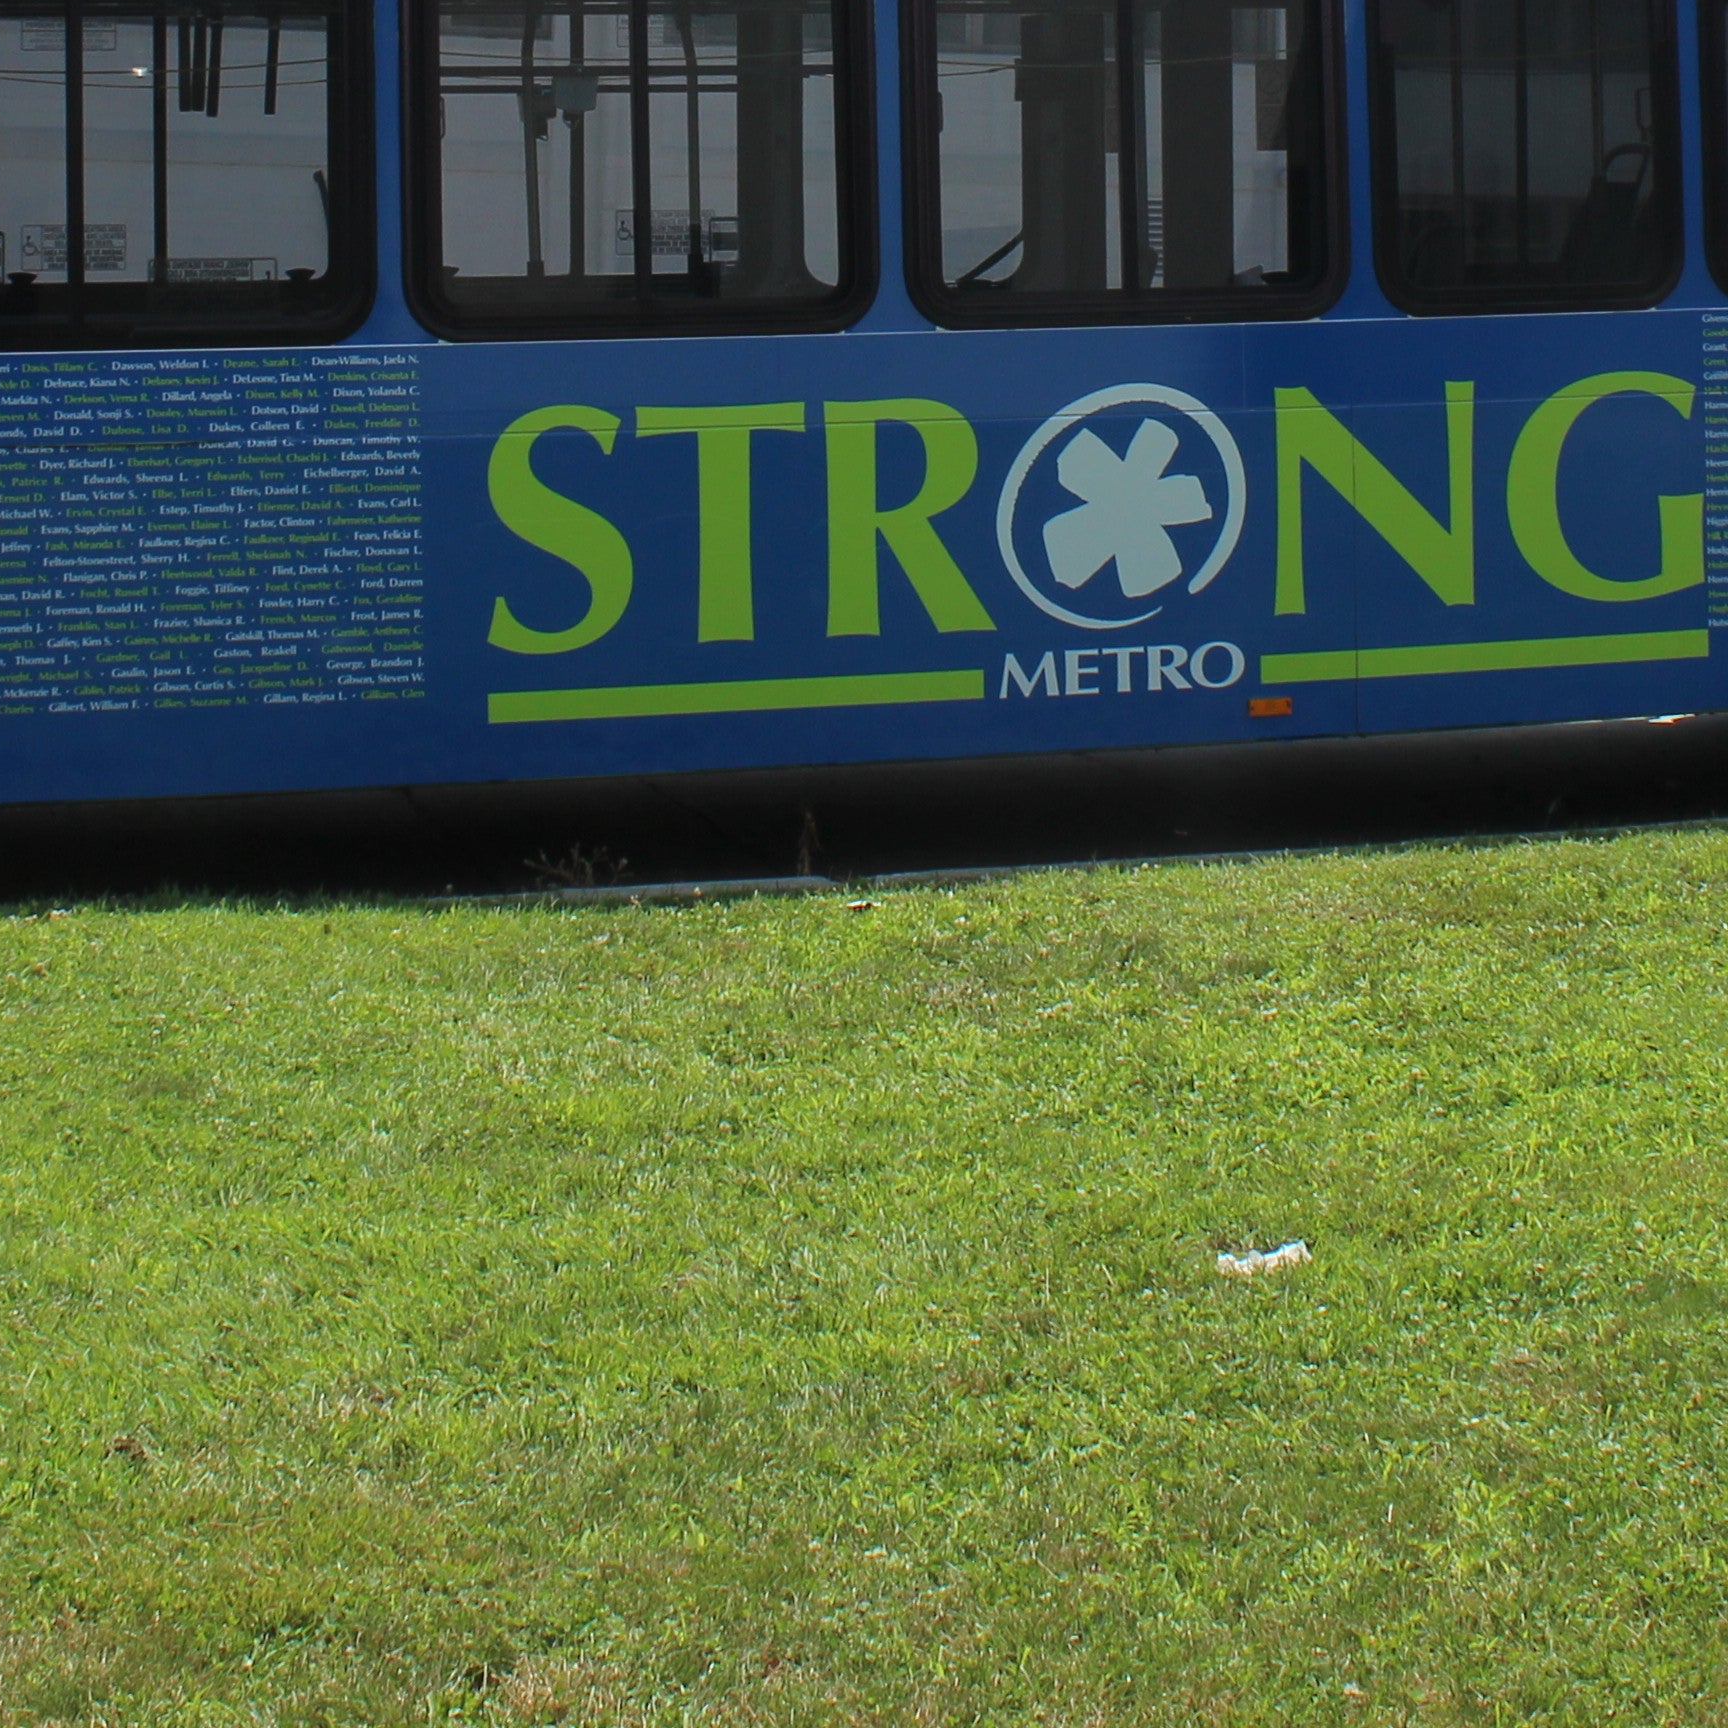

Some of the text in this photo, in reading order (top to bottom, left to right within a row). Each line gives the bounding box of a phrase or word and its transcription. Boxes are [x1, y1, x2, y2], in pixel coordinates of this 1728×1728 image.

[1, 396, 38, 405] Markita
[162, 391, 197, 401] Dillard,
[200, 390, 232, 402] Angela
[333, 388, 365, 397] Dixon,
[368, 386, 406, 396] Yolanda
[252, 404, 319, 415] Dotson, David
[34, 427, 64, 437] David
[209, 422, 244, 432] Dukes,
[251, 421, 289, 431] Colleen
[40, 460, 66, 470] Dyer,
[69, 458, 107, 468] Richard
[84, 474, 130, 484] Edwards,
[136, 473, 173, 483] Sheena
[304, 468, 369, 478] Eichelberger,
[375, 466, 404, 476] David
[61, 492, 89, 501] Elam,
[93, 490, 125, 500] Victor
[41, 525, 72, 534] Evans,
[75, 523, 118, 535] Sapphire
[361, 578, 423, 588] Ford, Darren
[46, 607, 92, 615] Foreman,
[96, 603, 131, 613] Ronald
[260, 598, 293, 608] Fowler,
[298, 598, 325, 607] Harry
[1000, 643, 1244, 698] METRO
